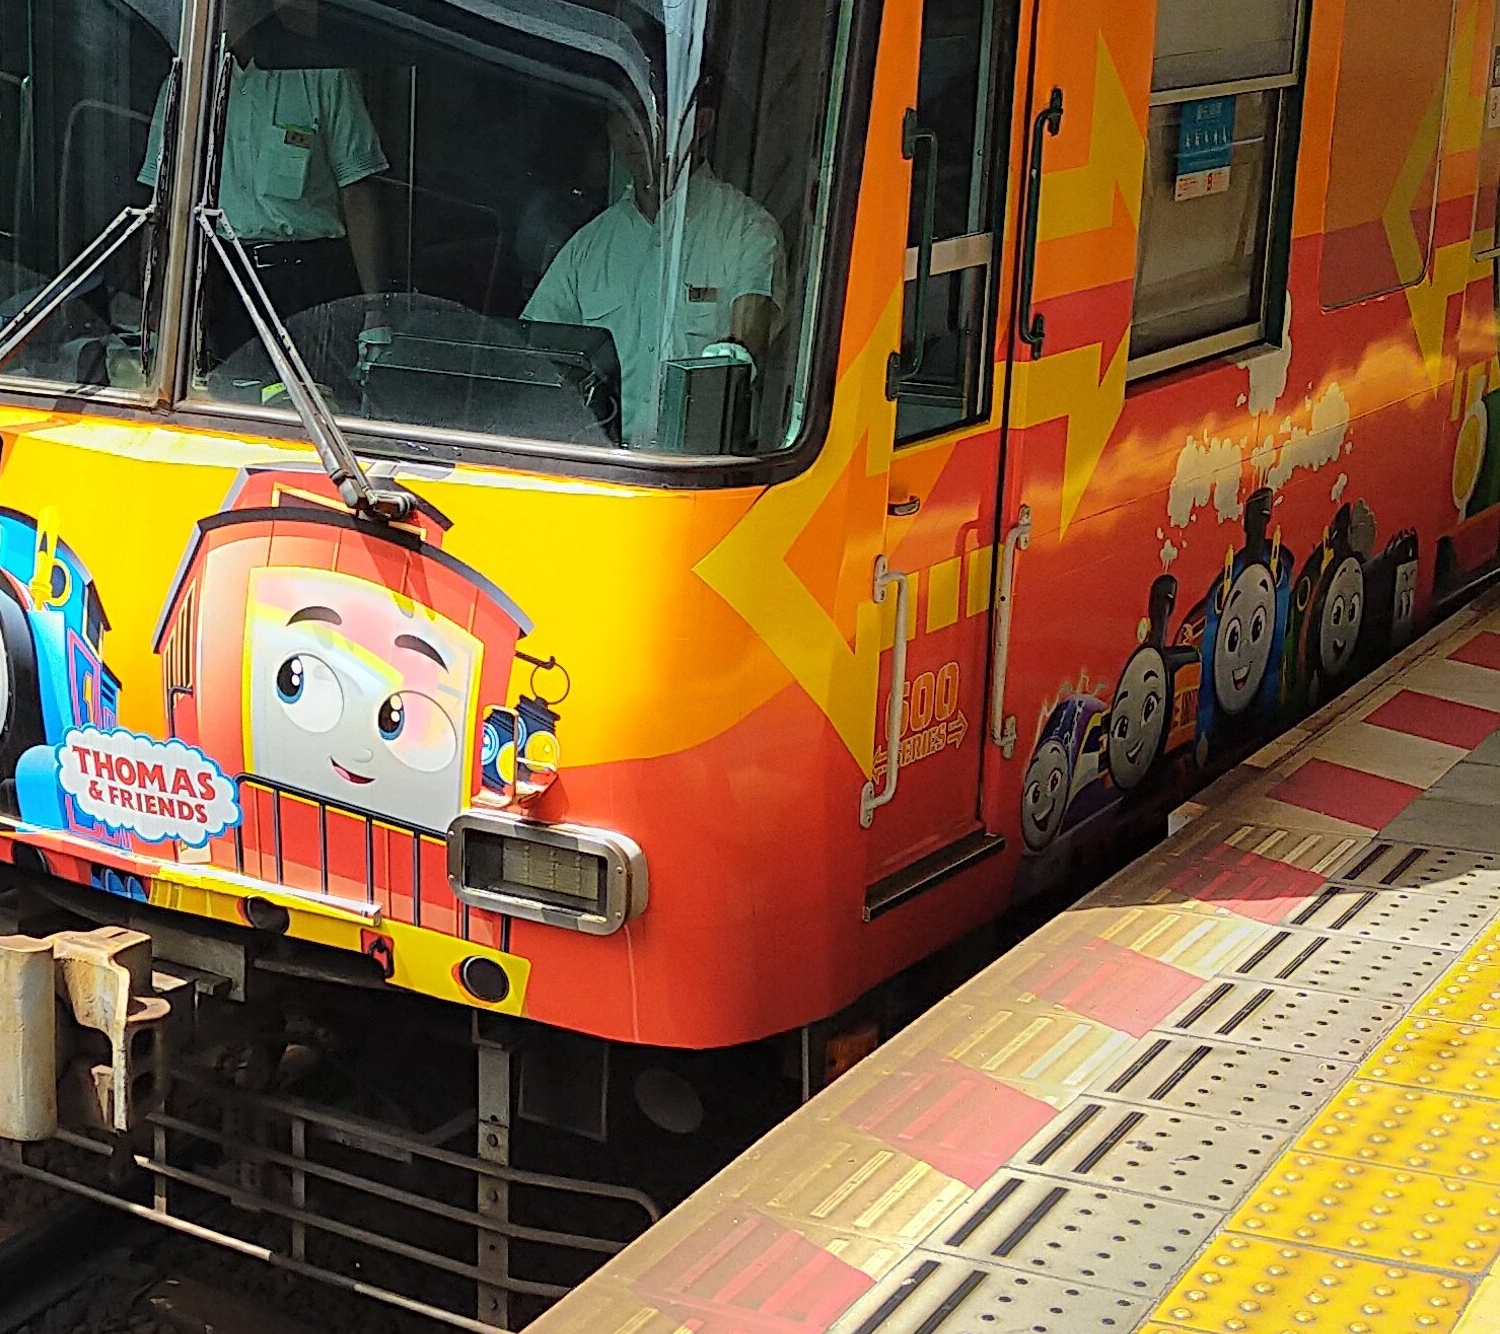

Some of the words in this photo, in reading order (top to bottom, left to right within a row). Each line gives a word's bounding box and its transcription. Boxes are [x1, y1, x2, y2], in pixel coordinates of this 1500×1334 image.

[72, 744, 217, 801] THOMAS
[88, 779, 105, 802] &
[107, 785, 209, 824] FRIENDS
